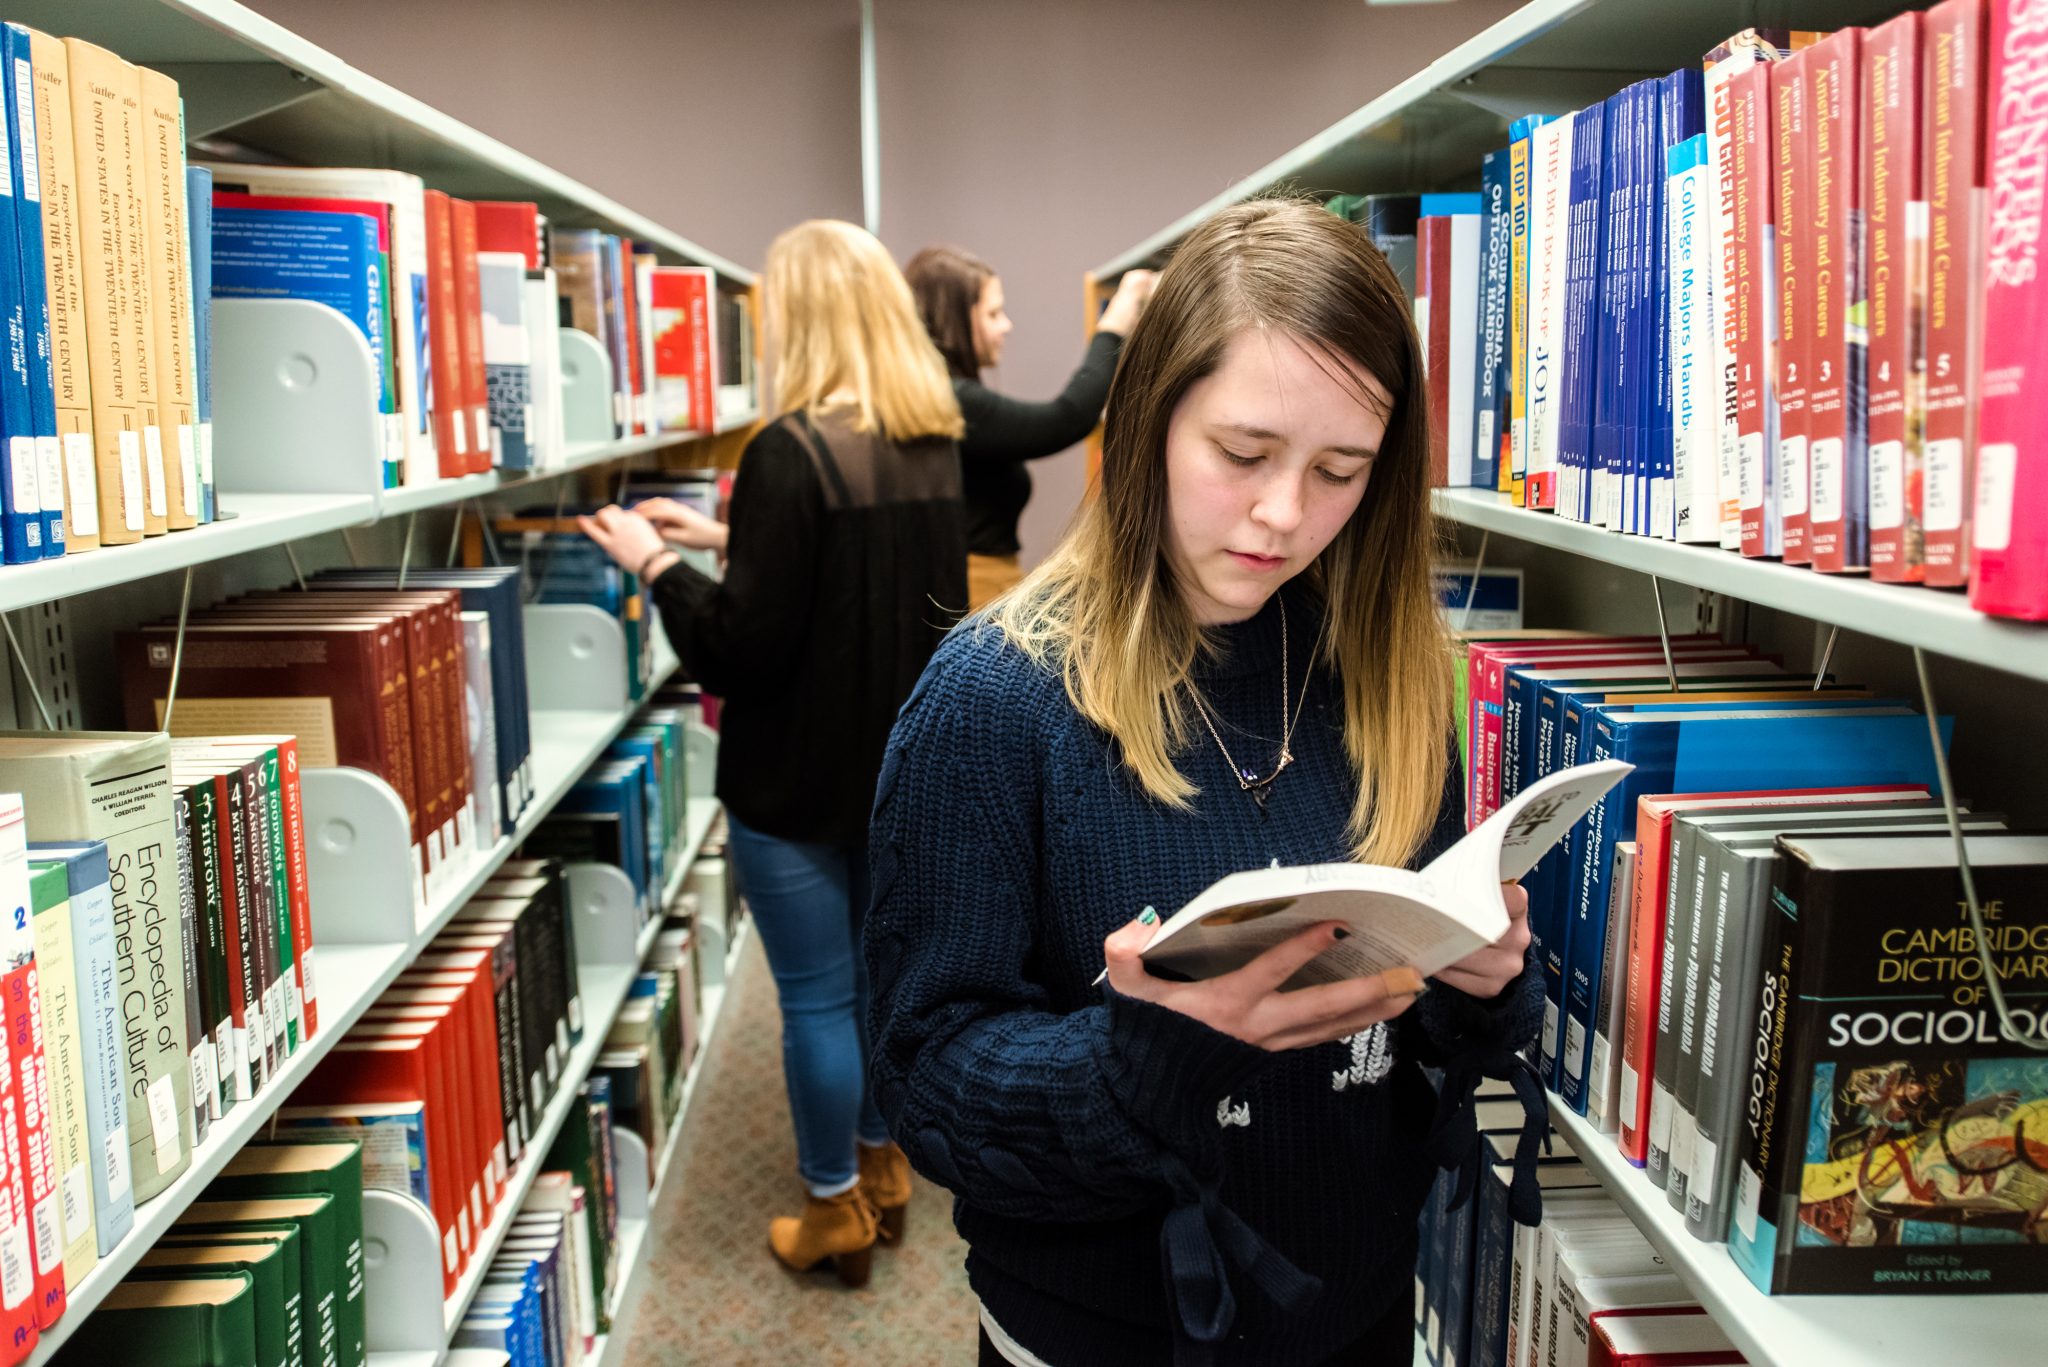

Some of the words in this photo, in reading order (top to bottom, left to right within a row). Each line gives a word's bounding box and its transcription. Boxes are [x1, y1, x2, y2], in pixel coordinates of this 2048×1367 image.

[33, 66, 62, 86] Kutler
[89, 81, 116, 101] Kutler
[1873, 55, 1889, 144] American
[1935, 32, 1954, 127] American
[93, 100, 105, 152] UNITED
[154, 107, 175, 124] Kutler
[1735, 99, 1746, 175] American
[1779, 85, 1792, 165] American
[1815, 68, 1830, 153] American
[157, 124, 168, 170] UNITED
[1513, 158, 1526, 195] TOP
[1548, 131, 1560, 183] THE
[1931, 129, 1954, 209] Industry
[97, 155, 110, 205] STATES
[161, 173, 172, 219] STATES
[1780, 168, 1795, 237] Industry
[1815, 156, 1833, 229] Industry
[1871, 147, 1890, 223] Industry
[51, 219, 62, 250] THE
[61, 183, 76, 270] Encyclopedia
[100, 208, 111, 225] IN
[112, 192, 125, 275] Encyclopedia
[162, 221, 173, 237] IN
[1487, 183, 1503, 281] OUTLOOK
[1513, 200, 1526, 238] 100
[1679, 174, 1696, 262] College
[1737, 177, 1749, 244] Industry
[1933, 215, 1952, 251] and
[103, 227, 113, 256] THE
[165, 239, 175, 266] THE
[1542, 235, 1556, 305] BOOK
[1738, 248, 1750, 278] and
[1783, 242, 1796, 273] and
[1817, 234, 1832, 267] and
[1874, 228, 1891, 263] and
[52, 253, 69, 335] TWENTIETH
[69, 274, 78, 289] of
[70, 290, 78, 313] the
[104, 258, 120, 338] TWENTIETH
[130, 261, 144, 336] TWENTIETH
[167, 268, 180, 340] TWENTIETH
[1493, 211, 1511, 369] OCCUPATIONAL
[1678, 268, 1695, 347] Majors
[1783, 276, 1796, 341] Careers
[1817, 270, 1832, 338] Careers
[1874, 265, 1890, 337] Careers
[1932, 254, 1951, 329] Careers
[1482, 286, 1498, 398] HANDBOOK
[1739, 281, 1750, 343] Careers
[9, 317, 22, 373] 1981-1988
[59, 338, 74, 403] CENTURY
[110, 340, 124, 401] CENTURY
[136, 338, 149, 397] CENTURY
[172, 341, 183, 398] CENTURY
[1744, 363, 1752, 382] 1
[1787, 362, 1797, 383] 2
[1819, 360, 1831, 382] 3
[1877, 360, 1891, 382] 4
[1935, 352, 1951, 378] 5
[1681, 351, 1694, 429] Handb
[1503, 697, 1516, 791] American
[1513, 701, 1522, 761] Hoover's
[1537, 716, 1547, 777] Private
[1544, 720, 1554, 774] Hoover's
[91, 793, 117, 804] CHARLES
[118, 786, 143, 798] REAGAN
[144, 779, 168, 790] WILSON
[248, 773, 256, 799] 5
[258, 762, 267, 787] 6
[269, 758, 278, 783] 7
[287, 750, 297, 773] 8
[1486, 731, 1498, 805] Business
[108, 798, 133, 810] WILLIAM
[133, 793, 157, 803] FERRIS,
[114, 804, 147, 818] COEDITORS
[176, 811, 184, 830] 1
[183, 801, 190, 818] 2
[202, 792, 212, 818] 3
[231, 782, 242, 807] 4
[231, 811, 243, 861] MYTH,
[248, 801, 261, 885] LANGUAGE
[258, 795, 272, 888] ETHNICITY
[270, 790, 283, 872] FOODWAYS
[287, 782, 304, 892] ENVIRONMENT
[1593, 803, 1607, 863] Handbook
[1672, 839, 1681, 856] THE
[201, 822, 216, 906] HISTORY
[1579, 830, 1597, 921] Companies
[1592, 864, 1600, 885] of
[1666, 857, 1681, 929] ENCYCLOPEDIA
[1698, 855, 1707, 871] THE
[1720, 871, 1730, 891] THE
[14, 906, 27, 931] 2
[176, 835, 188, 919] RELIGION
[182, 929, 190, 961] WILSON
[235, 862, 247, 940] MANNERS,
[1692, 872, 1706, 946] ENCYCLOPEDIA
[1713, 892, 1729, 964] ENCYCLOPEDIA
[1956, 900, 2005, 921] THE
[109, 853, 137, 986] Southern
[123, 990, 150, 1099] Culture
[136, 843, 173, 1022] Encyclopedia
[158, 1025, 178, 1054] of
[1549, 949, 1562, 967] 2005
[1574, 967, 1589, 987] 2005
[1781, 943, 1793, 973] THE
[1877, 953, 2048, 984] DICTIONAR
[11, 978, 24, 1003] on
[55, 984, 66, 1028] The
[100, 959, 112, 1001] The
[1658, 938, 1676, 1034] PROPAGANDA
[1679, 957, 1700, 1056] PROPAGANDA
[1952, 985, 1988, 1006] OF
[15, 1014, 29, 1046] the
[26, 968, 44, 1054] GLOBAL
[1700, 976, 1722, 1078] PROPAGANDA
[1771, 975, 1790, 1071] CAMBRIDGE
[58, 1031, 75, 1122] American
[104, 1005, 119, 1090] American
[1747, 970, 1778, 1140] SOCIOLOGY
[19, 1054, 40, 1129] UNITED
[1758, 1069, 1780, 1171] DICTIONARY
[27, 1130, 47, 1201] STATES
[1873, 1269, 1921, 1283] BRYAN
[1936, 1269, 1992, 1282] TURNER
[1905, 1253, 1945, 1266] Edited
[1946, 1253, 1963, 1267] by
[1510, 1257, 1523, 1327] AMERICAN
[1531, 1275, 1543, 1348] AMERICAN
